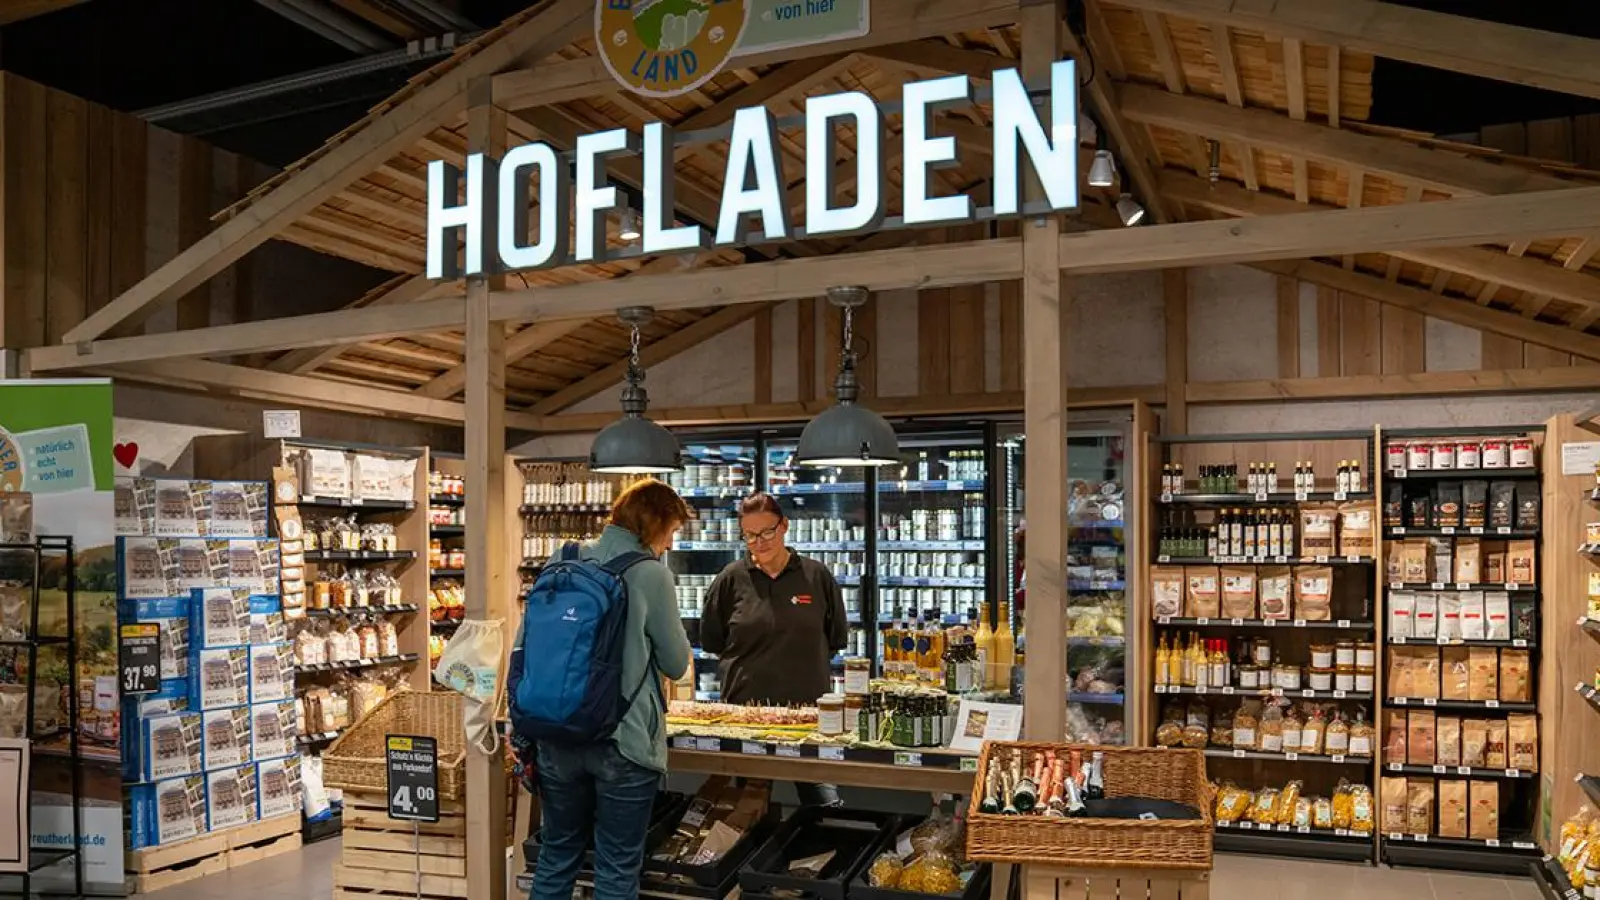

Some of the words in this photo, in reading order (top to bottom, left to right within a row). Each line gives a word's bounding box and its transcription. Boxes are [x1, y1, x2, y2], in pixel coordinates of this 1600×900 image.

[775, 6, 801, 21] von
[806, 0, 836, 16] hier
[630, 49, 698, 82] LAND
[426, 59, 1079, 280] HOFLADEN
[36, 440, 75, 455] natürlich
[37, 456, 57, 467] echt
[39, 472, 56, 480] von
[56, 469, 74, 478] hier
[32, 832, 106, 846] reutherld.de
